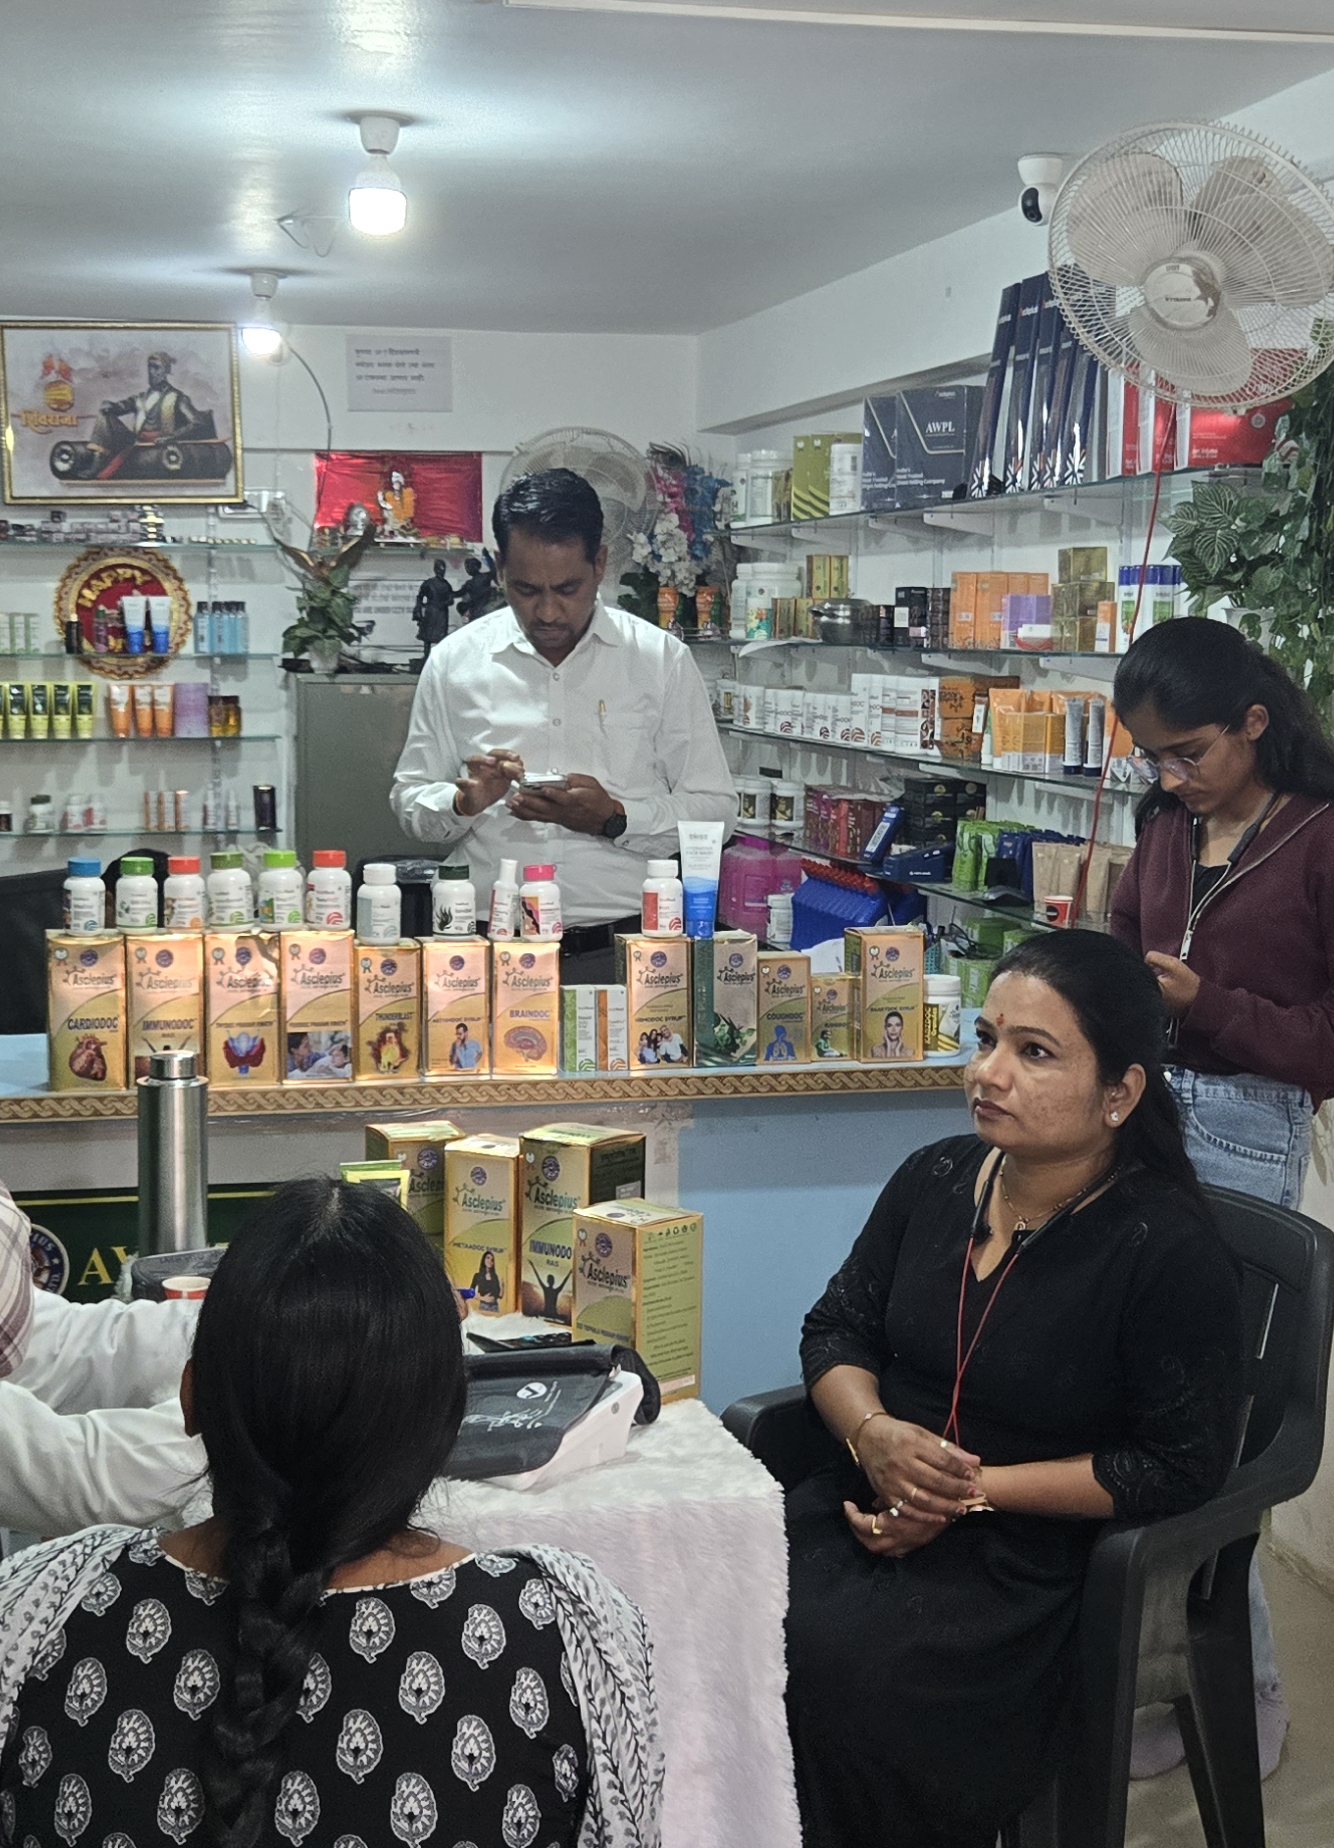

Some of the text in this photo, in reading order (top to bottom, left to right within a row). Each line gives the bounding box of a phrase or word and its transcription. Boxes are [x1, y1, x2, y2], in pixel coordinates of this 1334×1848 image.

[925, 421, 955, 434] AWPL
[72, 972, 117, 986] Asclepius
[301, 972, 344, 986] Asclepius
[644, 972, 682, 985] Asclepius
[724, 972, 755, 982] Asclepius
[878, 967, 914, 979] Asclepius
[373, 981, 413, 994] Asclepius
[442, 977, 480, 988] Asclepius
[511, 975, 552, 988] Asclepius
[771, 983, 804, 995] Asclepius
[509, 1009, 551, 1018] BRAINDOC
[67, 1016, 119, 1031] CARDIODOC
[142, 1018, 195, 1032] IMMUNODOC
[462, 1193, 504, 1211] Asclepius
[533, 1188, 578, 1210] Asclepius
[529, 1239, 572, 1260] IMMUNODO
[586, 1261, 629, 1290] Asclepius
